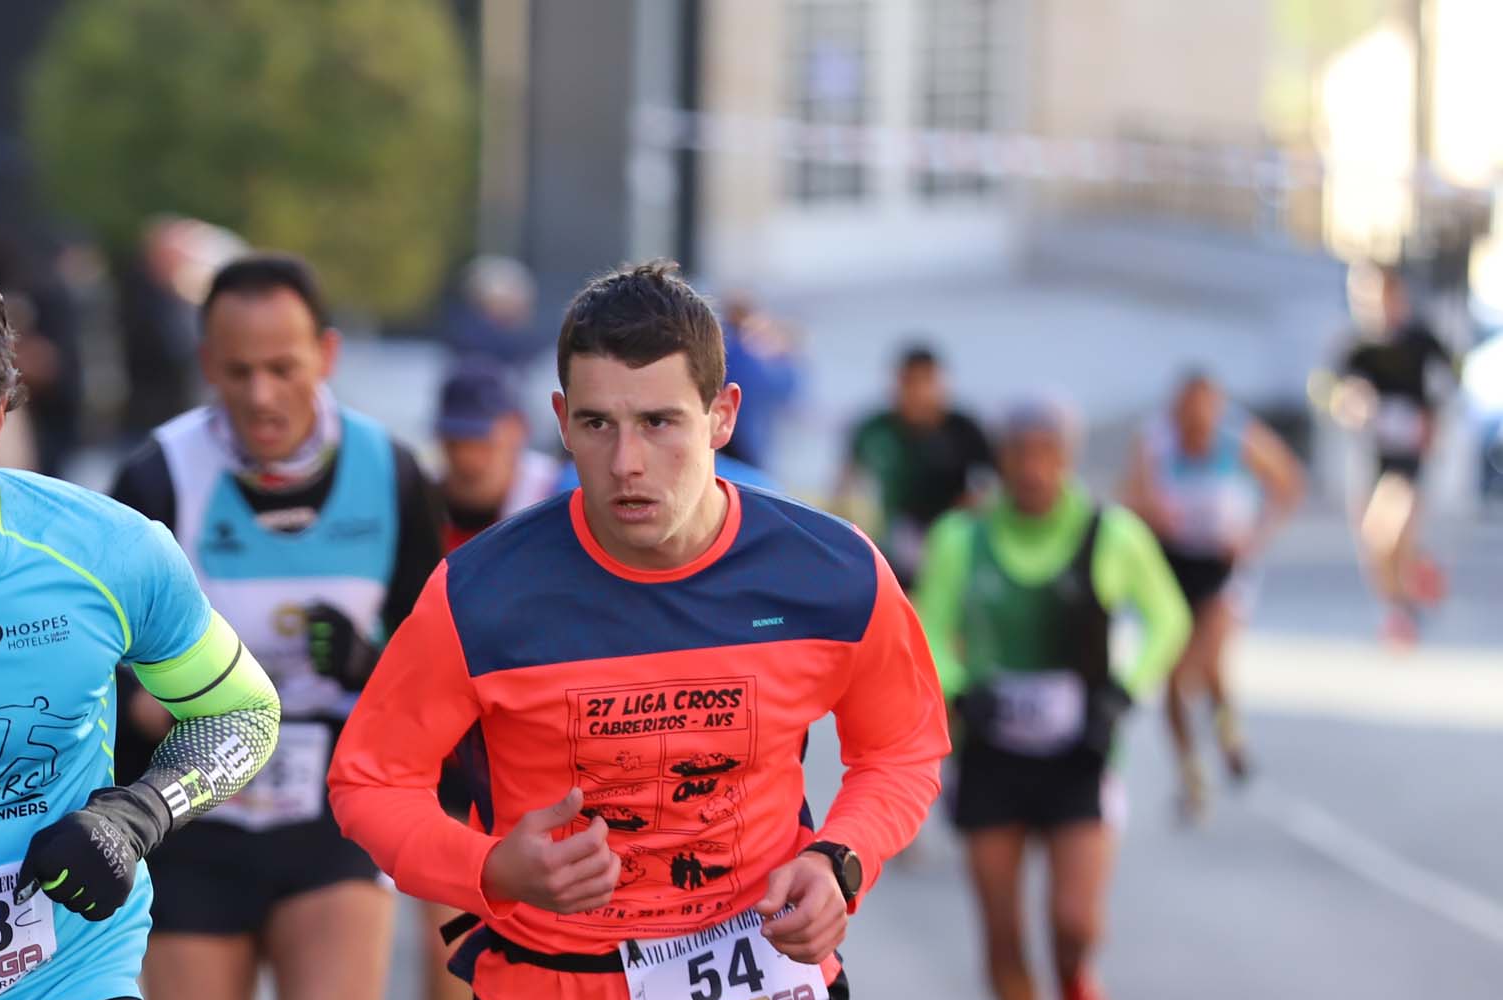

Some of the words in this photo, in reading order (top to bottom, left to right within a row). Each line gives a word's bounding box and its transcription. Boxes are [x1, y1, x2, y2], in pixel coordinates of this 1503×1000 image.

[5, 614, 69, 637] HOSPES
[7, 635, 50, 650] HOTELS
[586, 697, 616, 718] 27
[622, 692, 667, 716] LIGA
[674, 688, 743, 710] CROSS
[589, 714, 687, 736] CABRERIZOS
[704, 712, 735, 728] AVS
[90, 827, 128, 880] MEDIA
[666, 934, 693, 961] LIGA
[693, 919, 729, 949] CROSS
